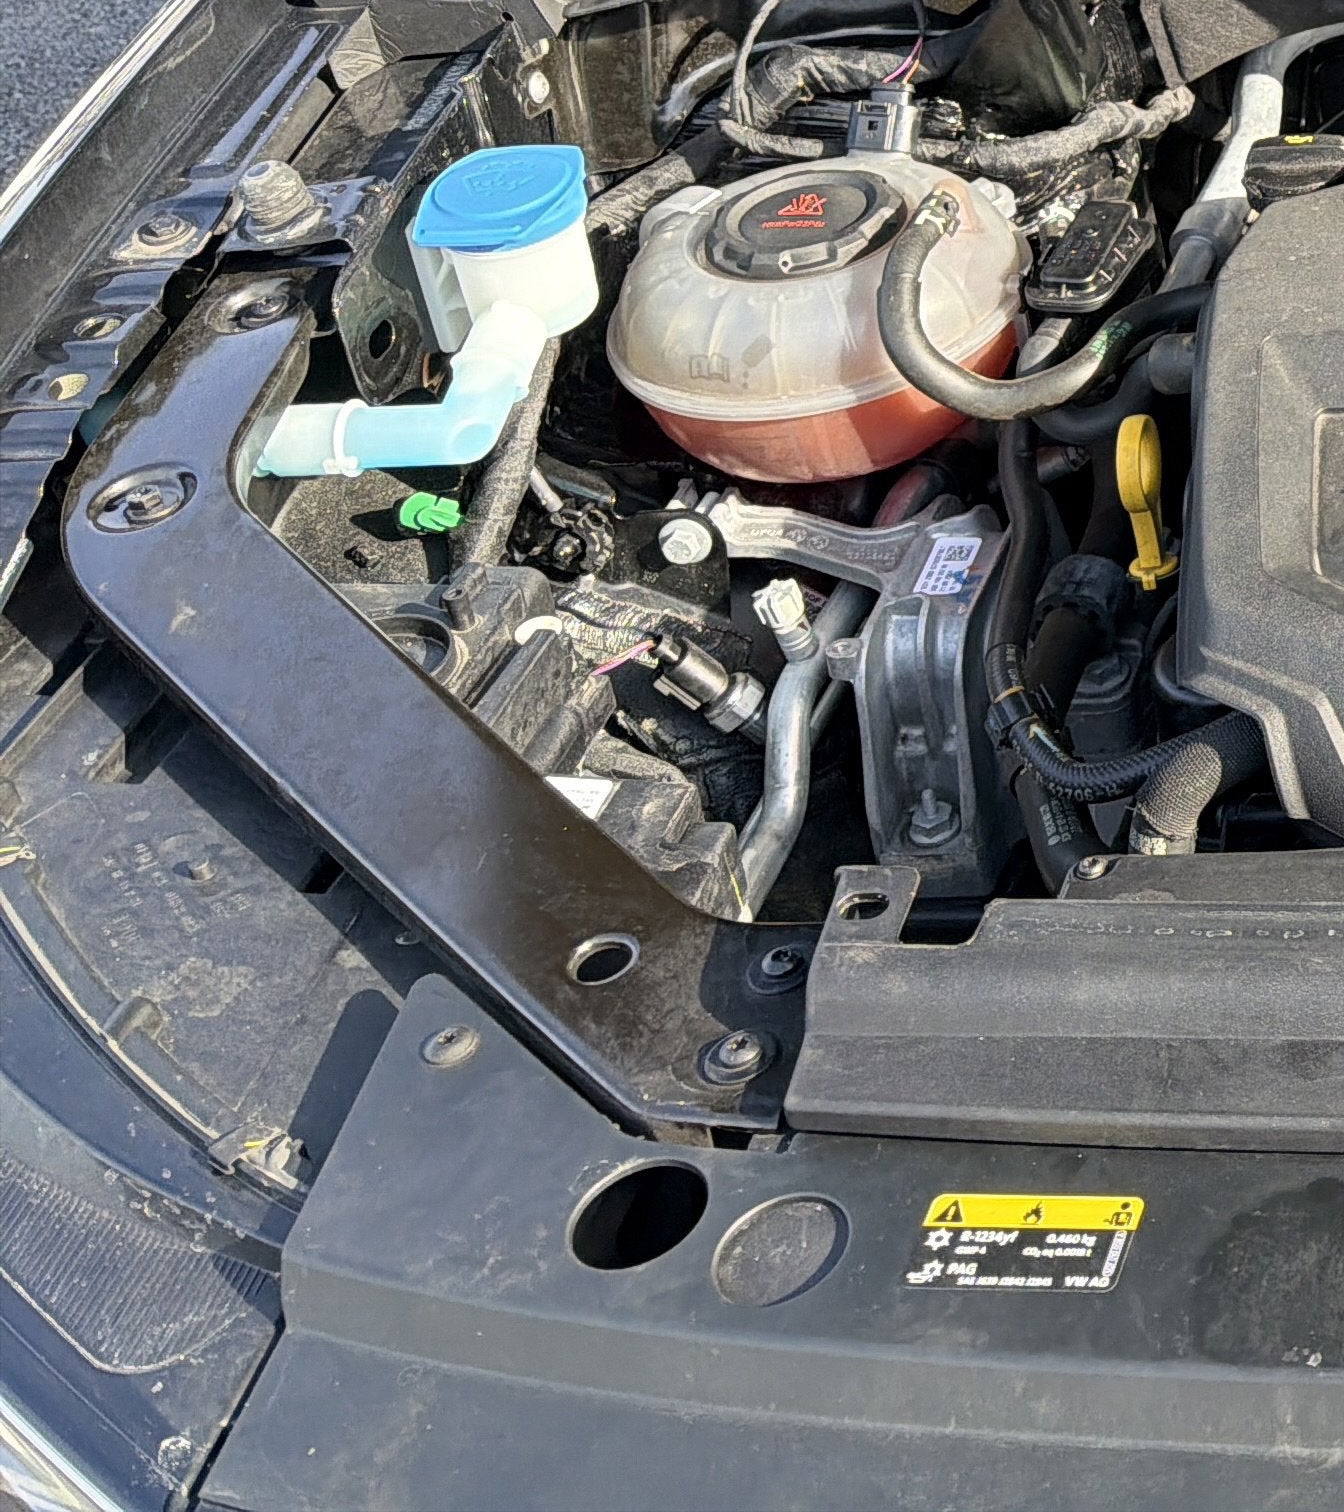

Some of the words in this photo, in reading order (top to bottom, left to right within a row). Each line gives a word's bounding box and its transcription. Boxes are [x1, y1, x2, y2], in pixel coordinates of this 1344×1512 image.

[959, 1230, 1020, 1247] R-1234yf
[1081, 1233, 1098, 1248] kg
[1041, 1248, 1055, 1259] eq
[945, 1261, 979, 1276] PAG
[955, 1275, 977, 1287] SAE
[1064, 1275, 1090, 1287] VW
[1087, 1275, 1111, 1288] AG
